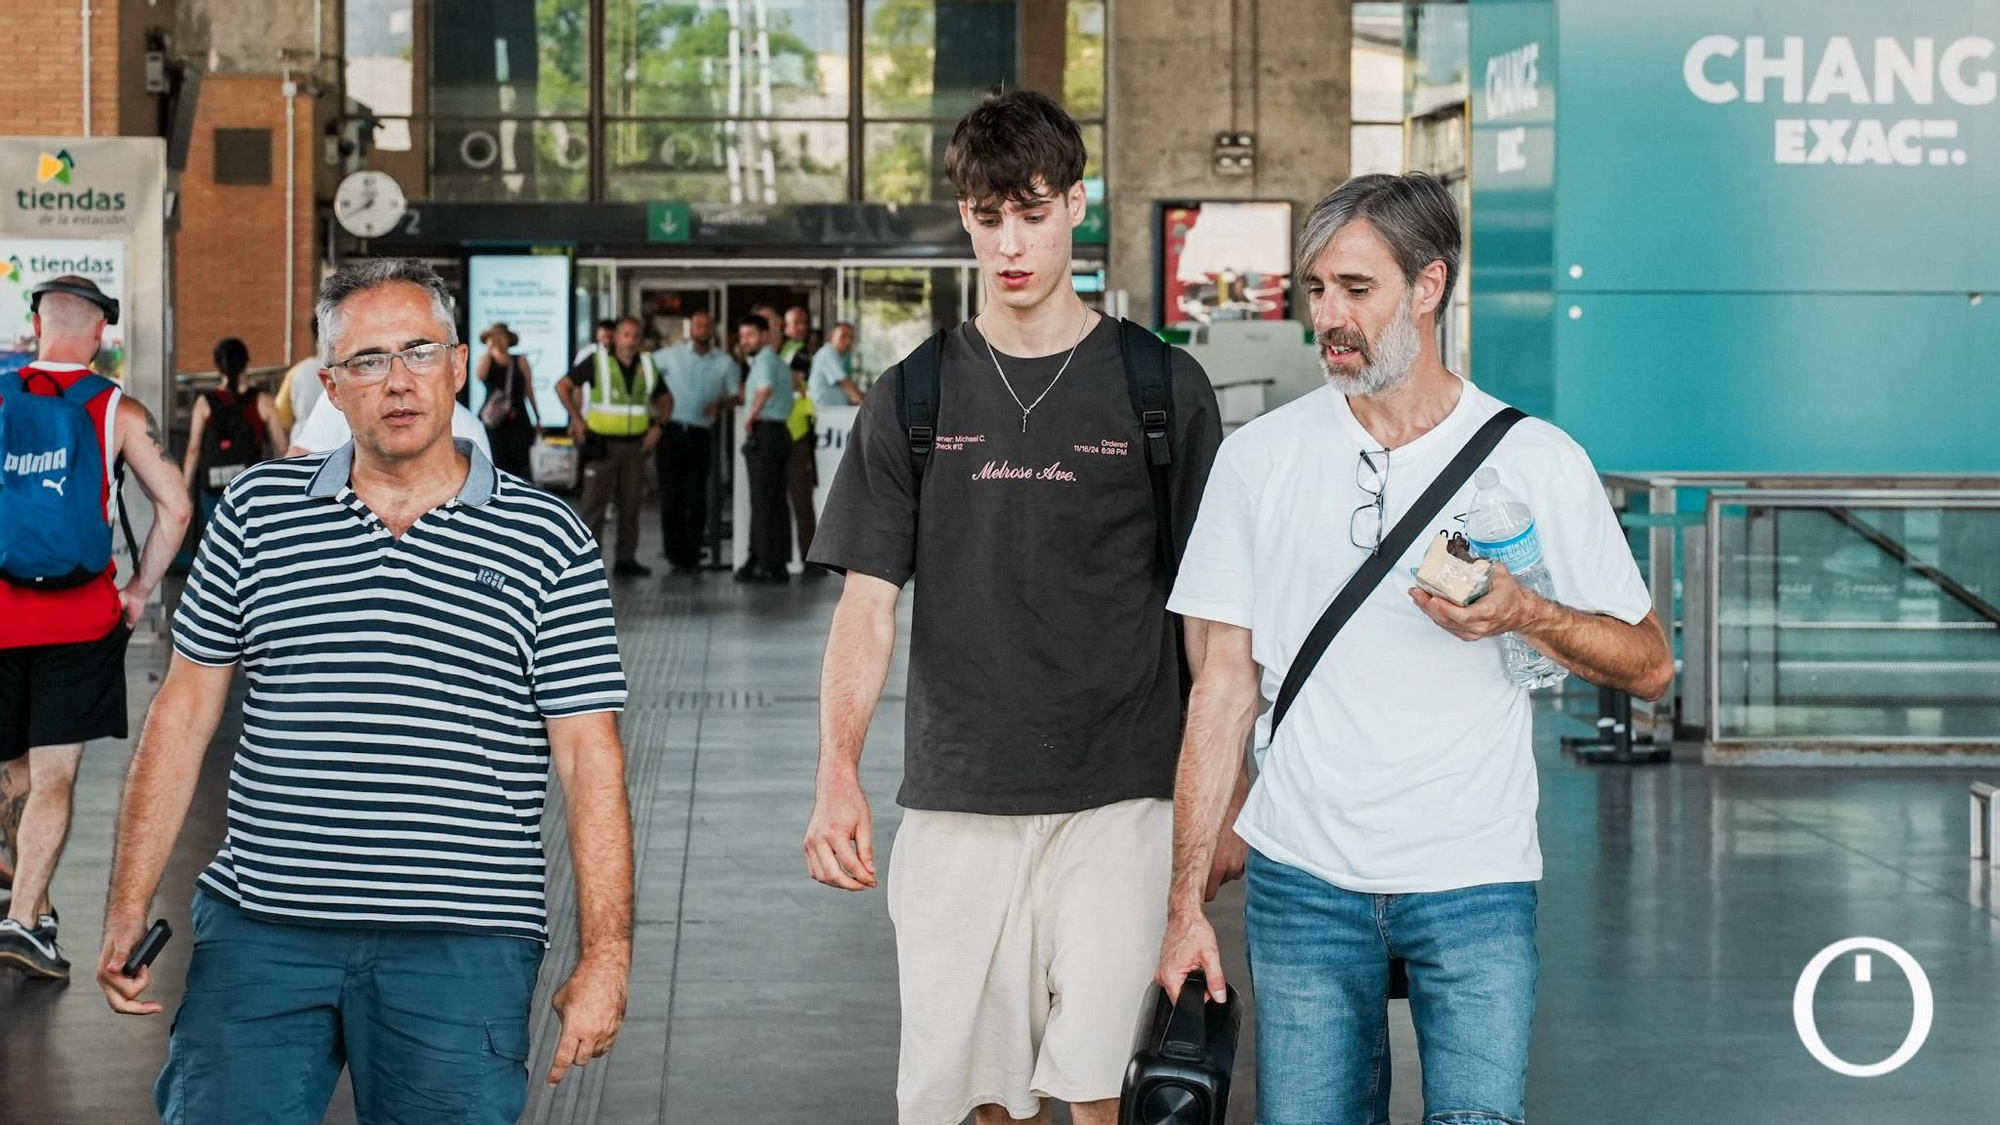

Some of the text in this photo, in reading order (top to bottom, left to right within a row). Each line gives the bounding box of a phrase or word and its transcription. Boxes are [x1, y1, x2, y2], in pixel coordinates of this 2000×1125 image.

[16, 188, 126, 211] tiendas
[30, 255, 114, 273] tiendas
[1101, 439, 1129, 449] Ordered
[1116, 448, 1128, 456] PM
[3, 446, 68, 476] PUMA
[971, 460, 1077, 482] Melrose Ave.
